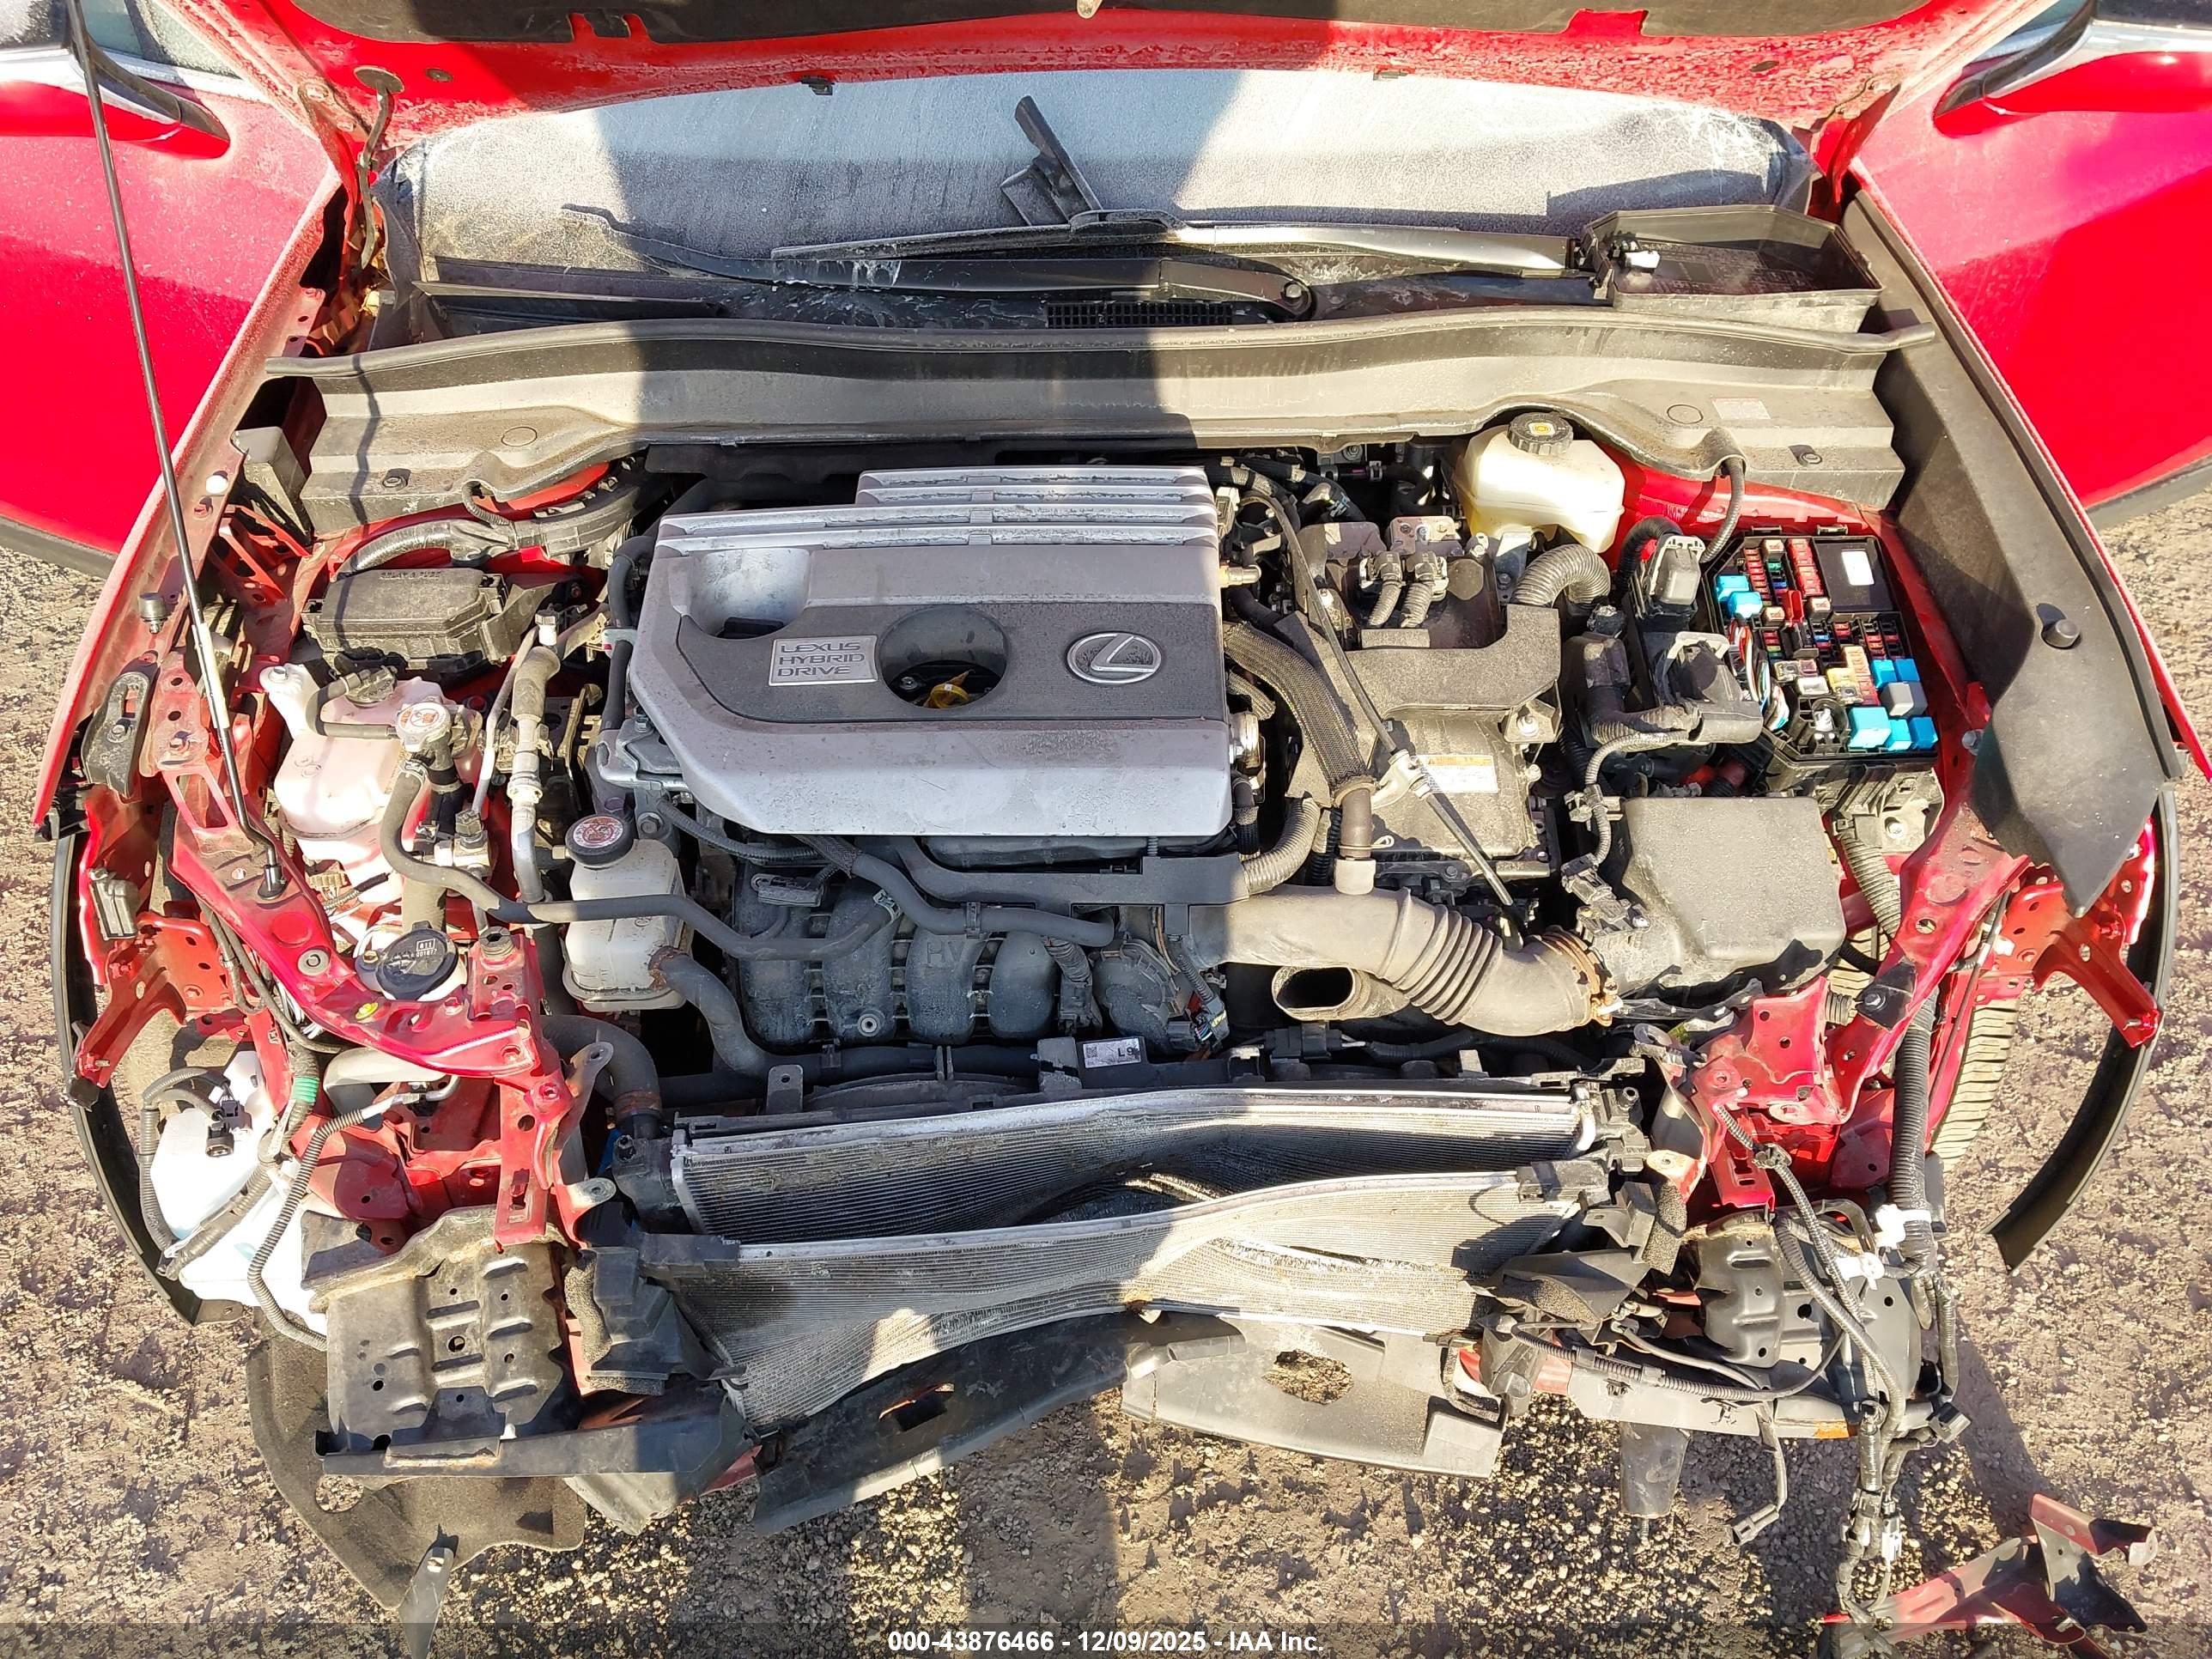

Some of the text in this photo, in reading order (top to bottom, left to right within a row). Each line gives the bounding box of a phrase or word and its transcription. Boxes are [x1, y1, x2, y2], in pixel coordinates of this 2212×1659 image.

[781, 641, 861, 653] LEXUS
[779, 653, 866, 665] HYBRID
[777, 665, 852, 677] DRIVE
